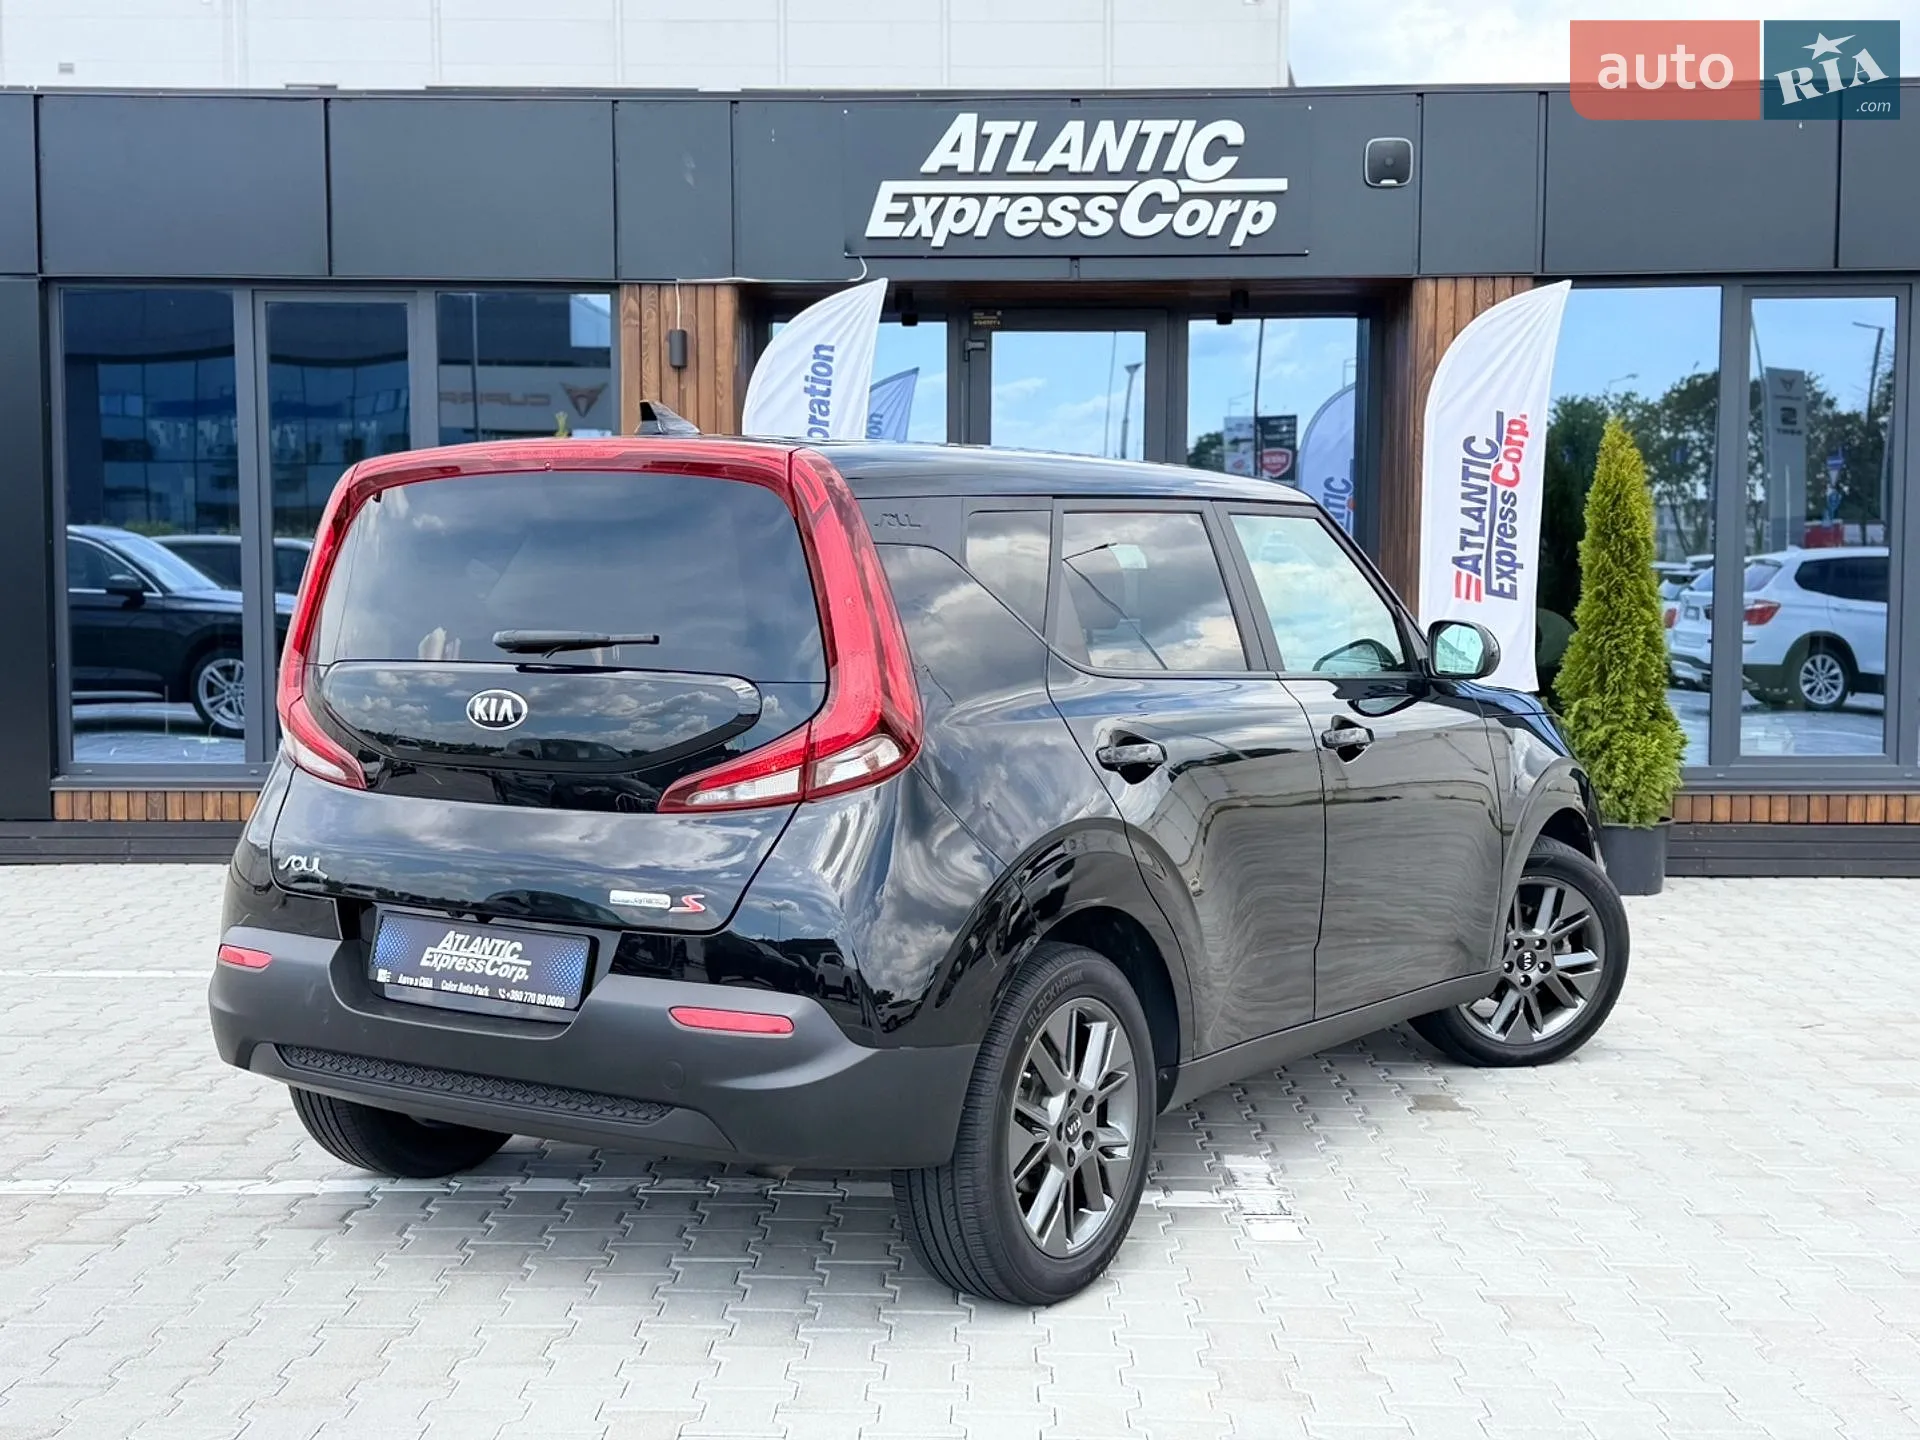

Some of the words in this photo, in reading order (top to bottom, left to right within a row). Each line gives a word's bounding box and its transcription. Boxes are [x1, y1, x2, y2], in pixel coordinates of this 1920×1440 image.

[920, 113, 1245, 182] ATLANTIC
[1452, 435, 1500, 577] ATLANTIC
[474, 697, 515, 722] KIA
[437, 930, 523, 960] ATLANTIC
[1523, 951, 1532, 970] KIA
[1067, 1115, 1082, 1136] KIA
